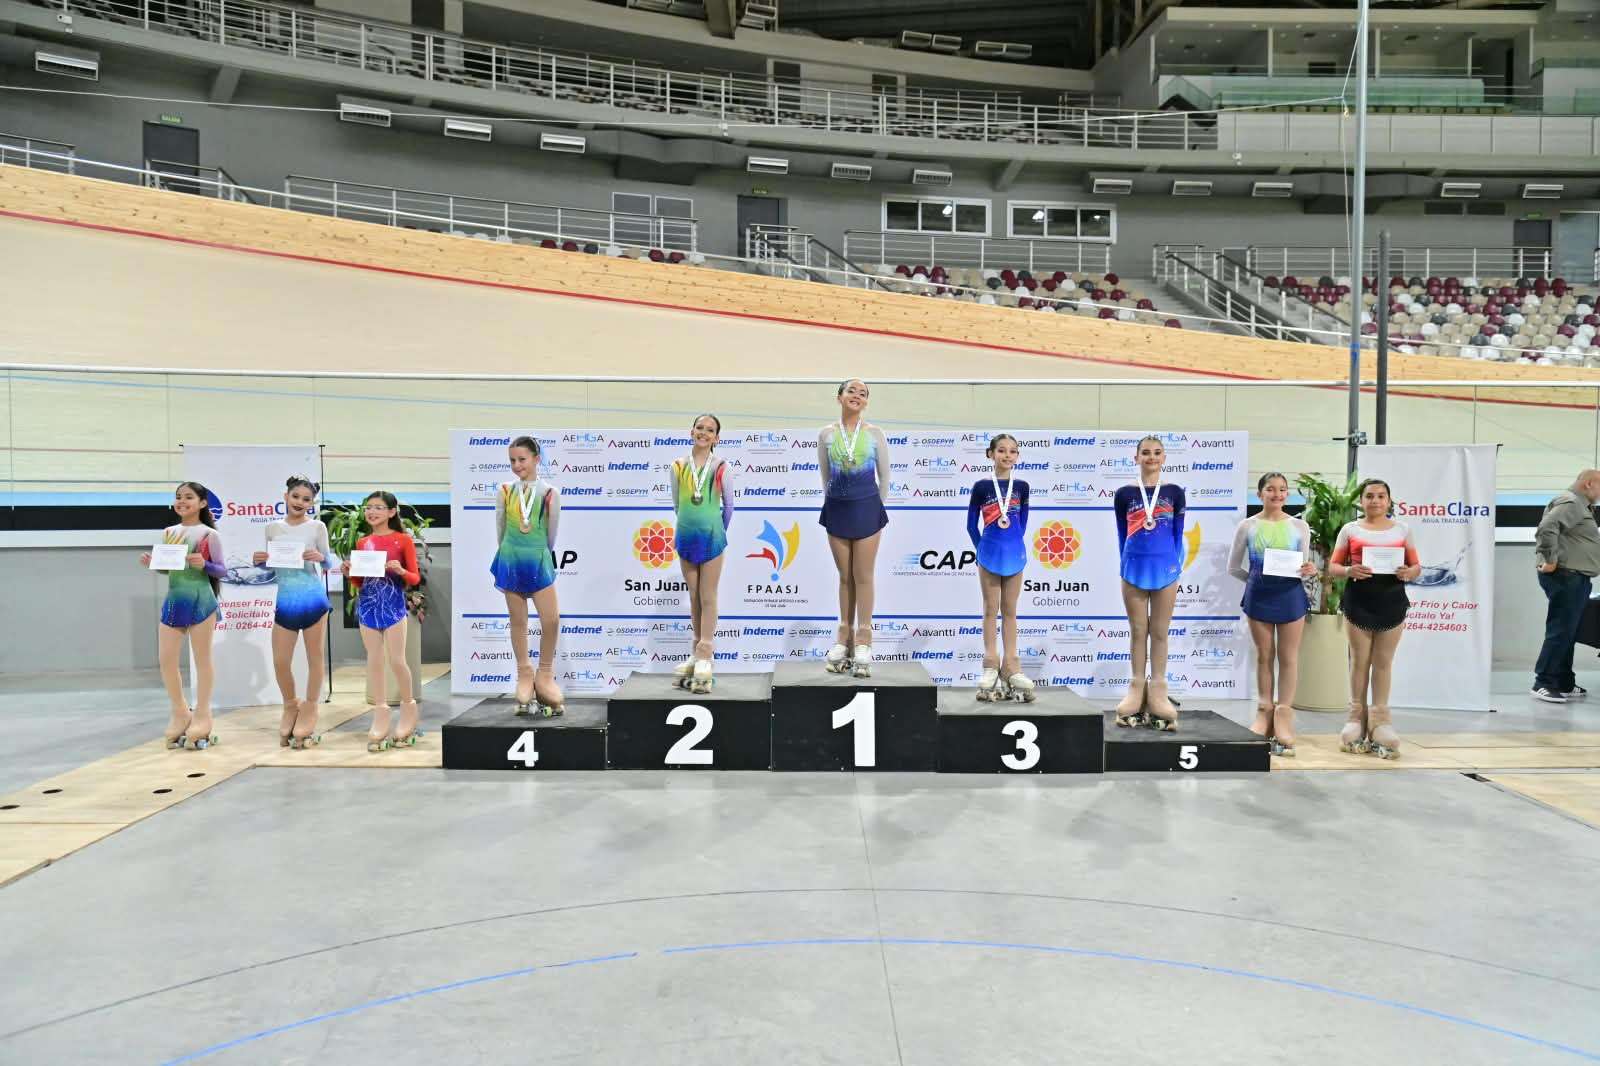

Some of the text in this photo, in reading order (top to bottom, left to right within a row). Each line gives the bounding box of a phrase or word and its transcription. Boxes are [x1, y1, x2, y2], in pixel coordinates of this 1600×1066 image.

[1398, 502, 1490, 516] SantaClara
[920, 550, 976, 569] CAP
[624, 579, 688, 591] San Juan
[1023, 579, 1090, 592] San Juan
[634, 596, 680, 606] Gobierno
[1032, 596, 1080, 607] Gobierno
[1442, 602, 1449, 610] y
[1451, 601, 1478, 609] Calor
[1440, 611, 1454, 619] Ya!
[664, 704, 713, 765] 2
[832, 692, 875, 766] 1
[507, 731, 539, 767] 4
[1001, 720, 1040, 770] 3
[1178, 745, 1199, 769] 5
